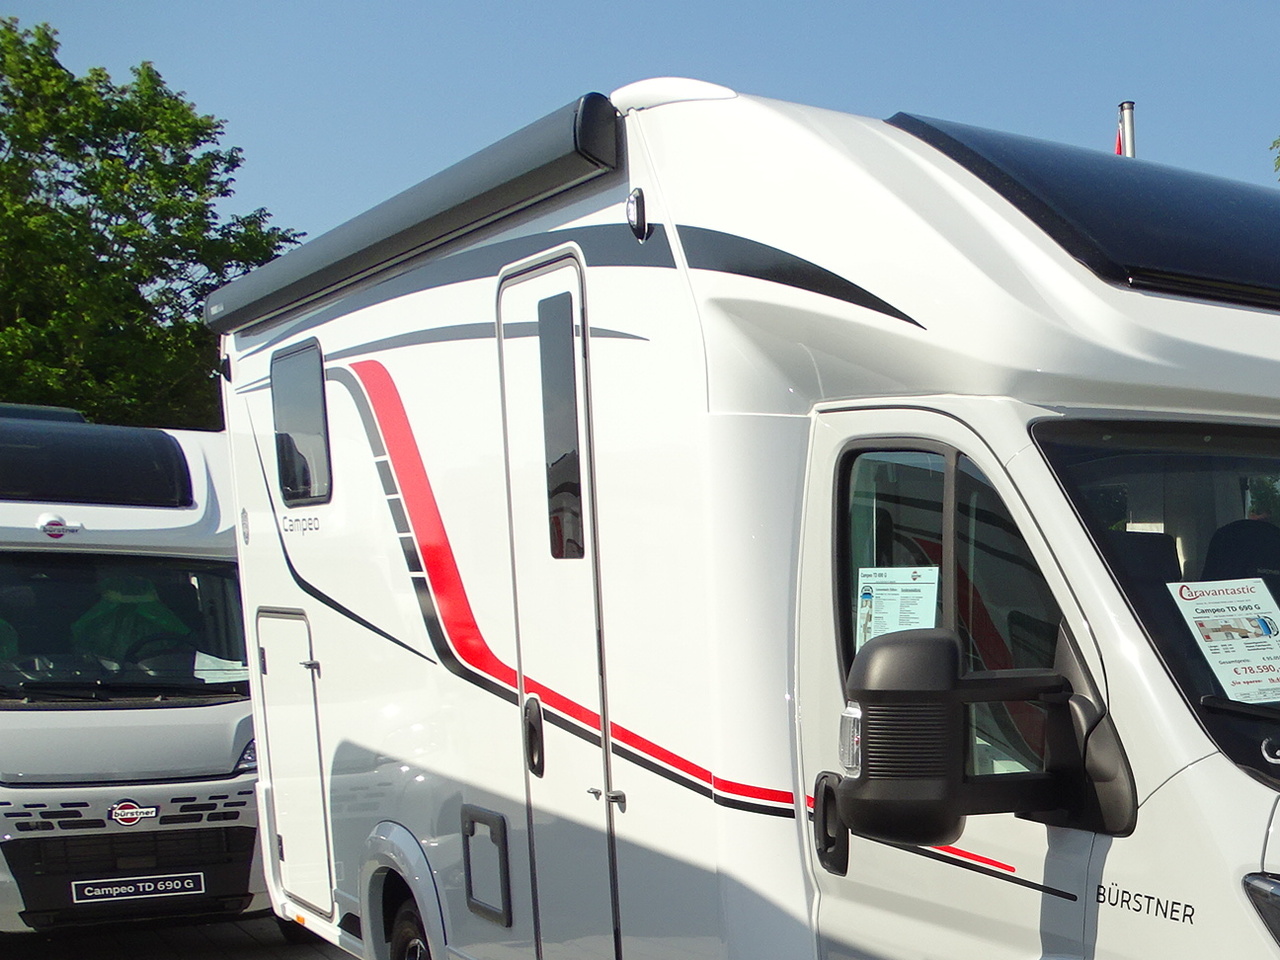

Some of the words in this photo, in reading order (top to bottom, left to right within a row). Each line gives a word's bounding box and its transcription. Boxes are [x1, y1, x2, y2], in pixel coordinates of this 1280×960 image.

[283, 516, 320, 536] Campeo
[1178, 584, 1256, 601] Caravantastic
[1194, 606, 1226, 615] Campeo
[1226, 605, 1238, 613] TD
[1238, 604, 1253, 612] 690
[114, 810, 155, 818] bürstner
[84, 885, 135, 897] Campeo
[137, 882, 155, 892] TD
[157, 880, 182, 891] 690
[184, 879, 195, 889] G
[1096, 882, 1196, 925] BÜRSTNER
